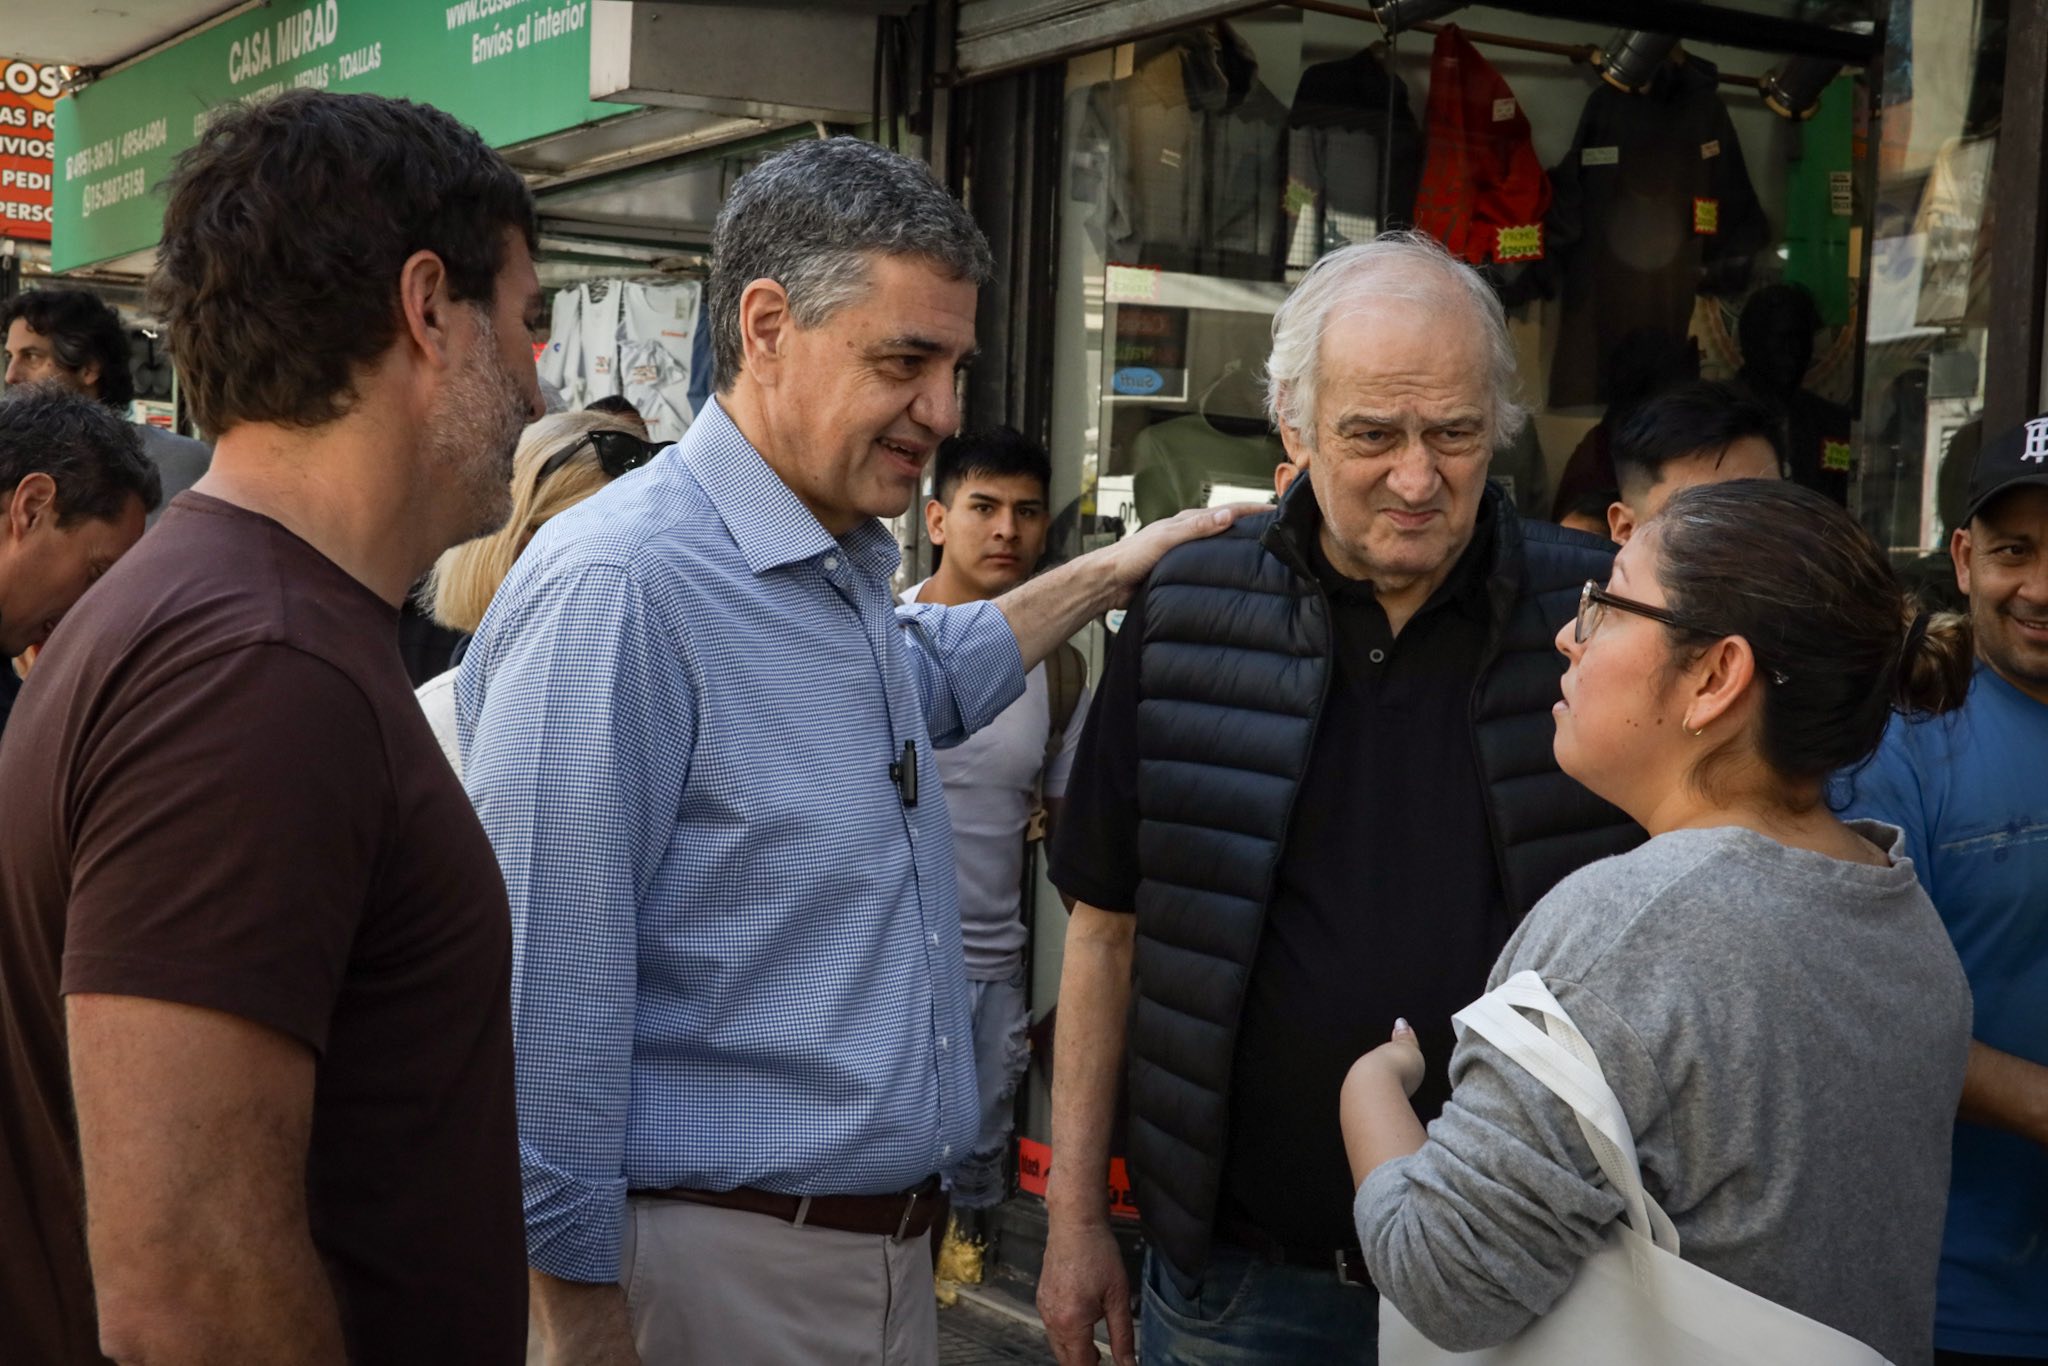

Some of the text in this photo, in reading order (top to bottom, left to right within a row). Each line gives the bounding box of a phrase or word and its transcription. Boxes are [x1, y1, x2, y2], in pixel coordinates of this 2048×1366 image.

[229, 0, 338, 84] CASA MURAD
[472, 1, 586, 64] Envíos al interior
[0, 62, 61, 98] OS
[294, 63, 329, 89] MEDIAS
[338, 42, 382, 81] TOALLAS
[0, 136, 54, 160] VIOS
[2, 169, 51, 191] PEDI
